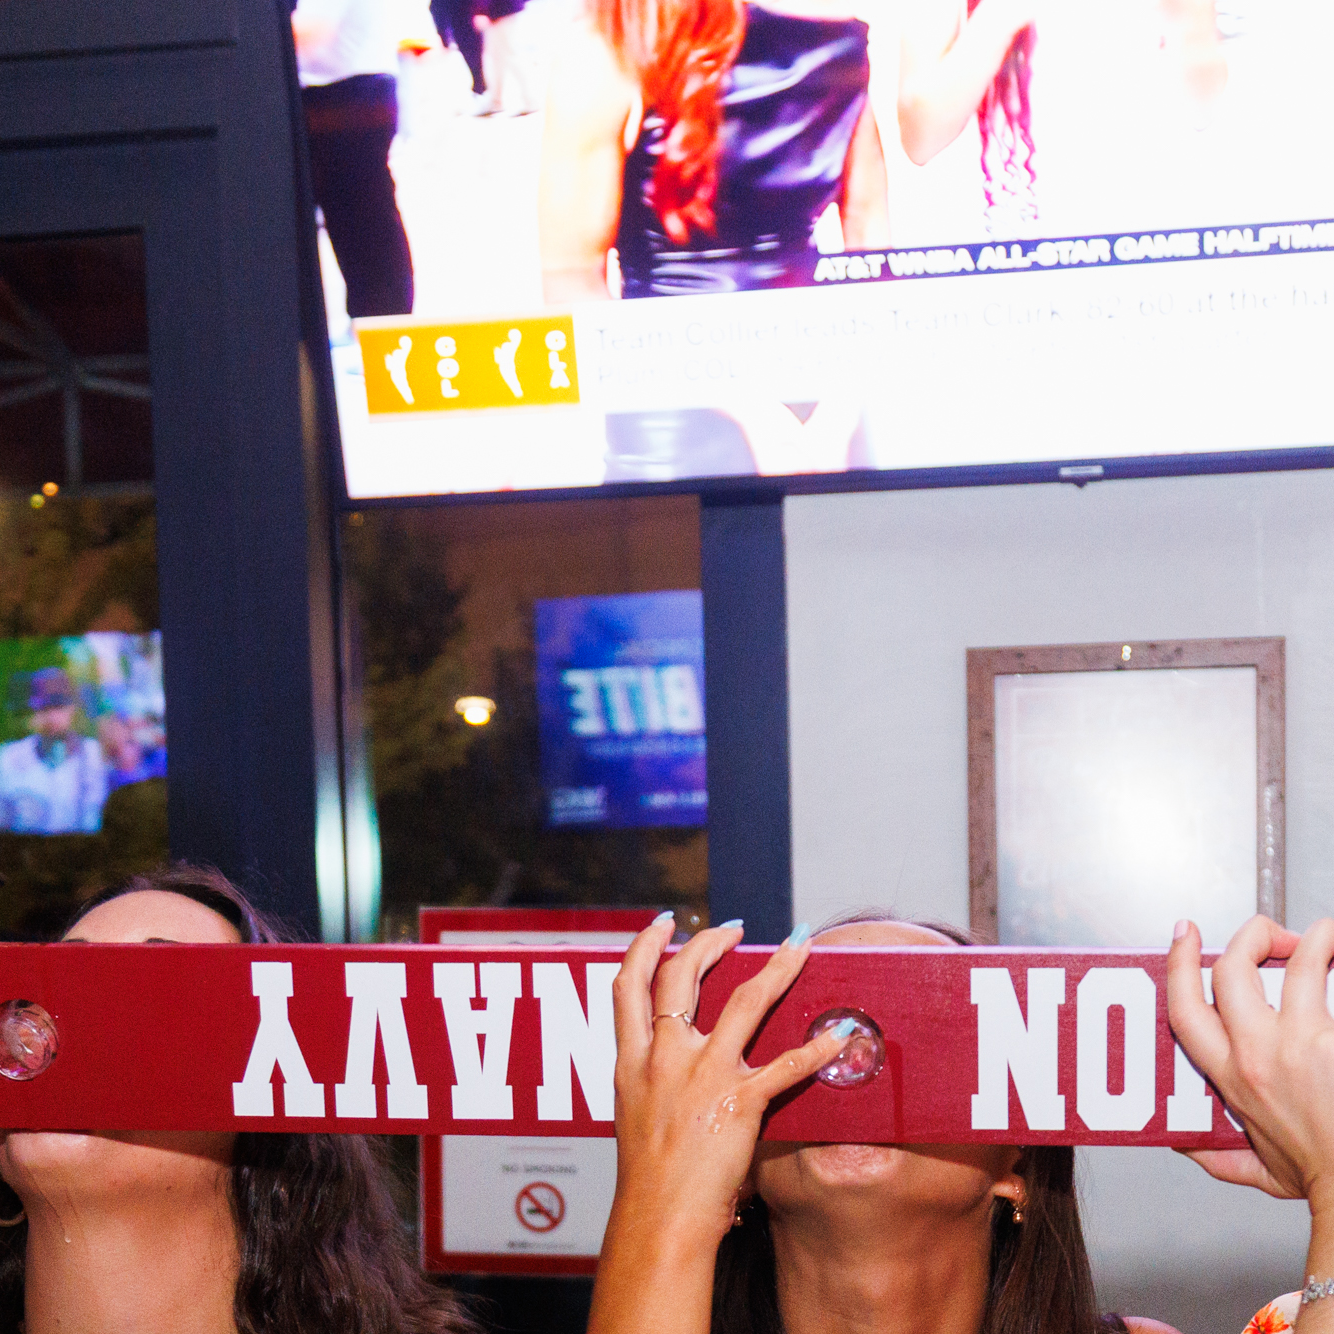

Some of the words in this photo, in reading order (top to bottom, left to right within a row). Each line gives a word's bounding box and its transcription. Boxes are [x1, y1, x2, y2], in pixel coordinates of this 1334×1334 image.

[813, 254, 886, 282] AT&T
[887, 247, 975, 277] WNBA
[976, 238, 1111, 271] ALL-STAR
[1114, 231, 1200, 261] GAME
[595, 327, 673, 352] Team
[232, 961, 622, 1121] NAVY
